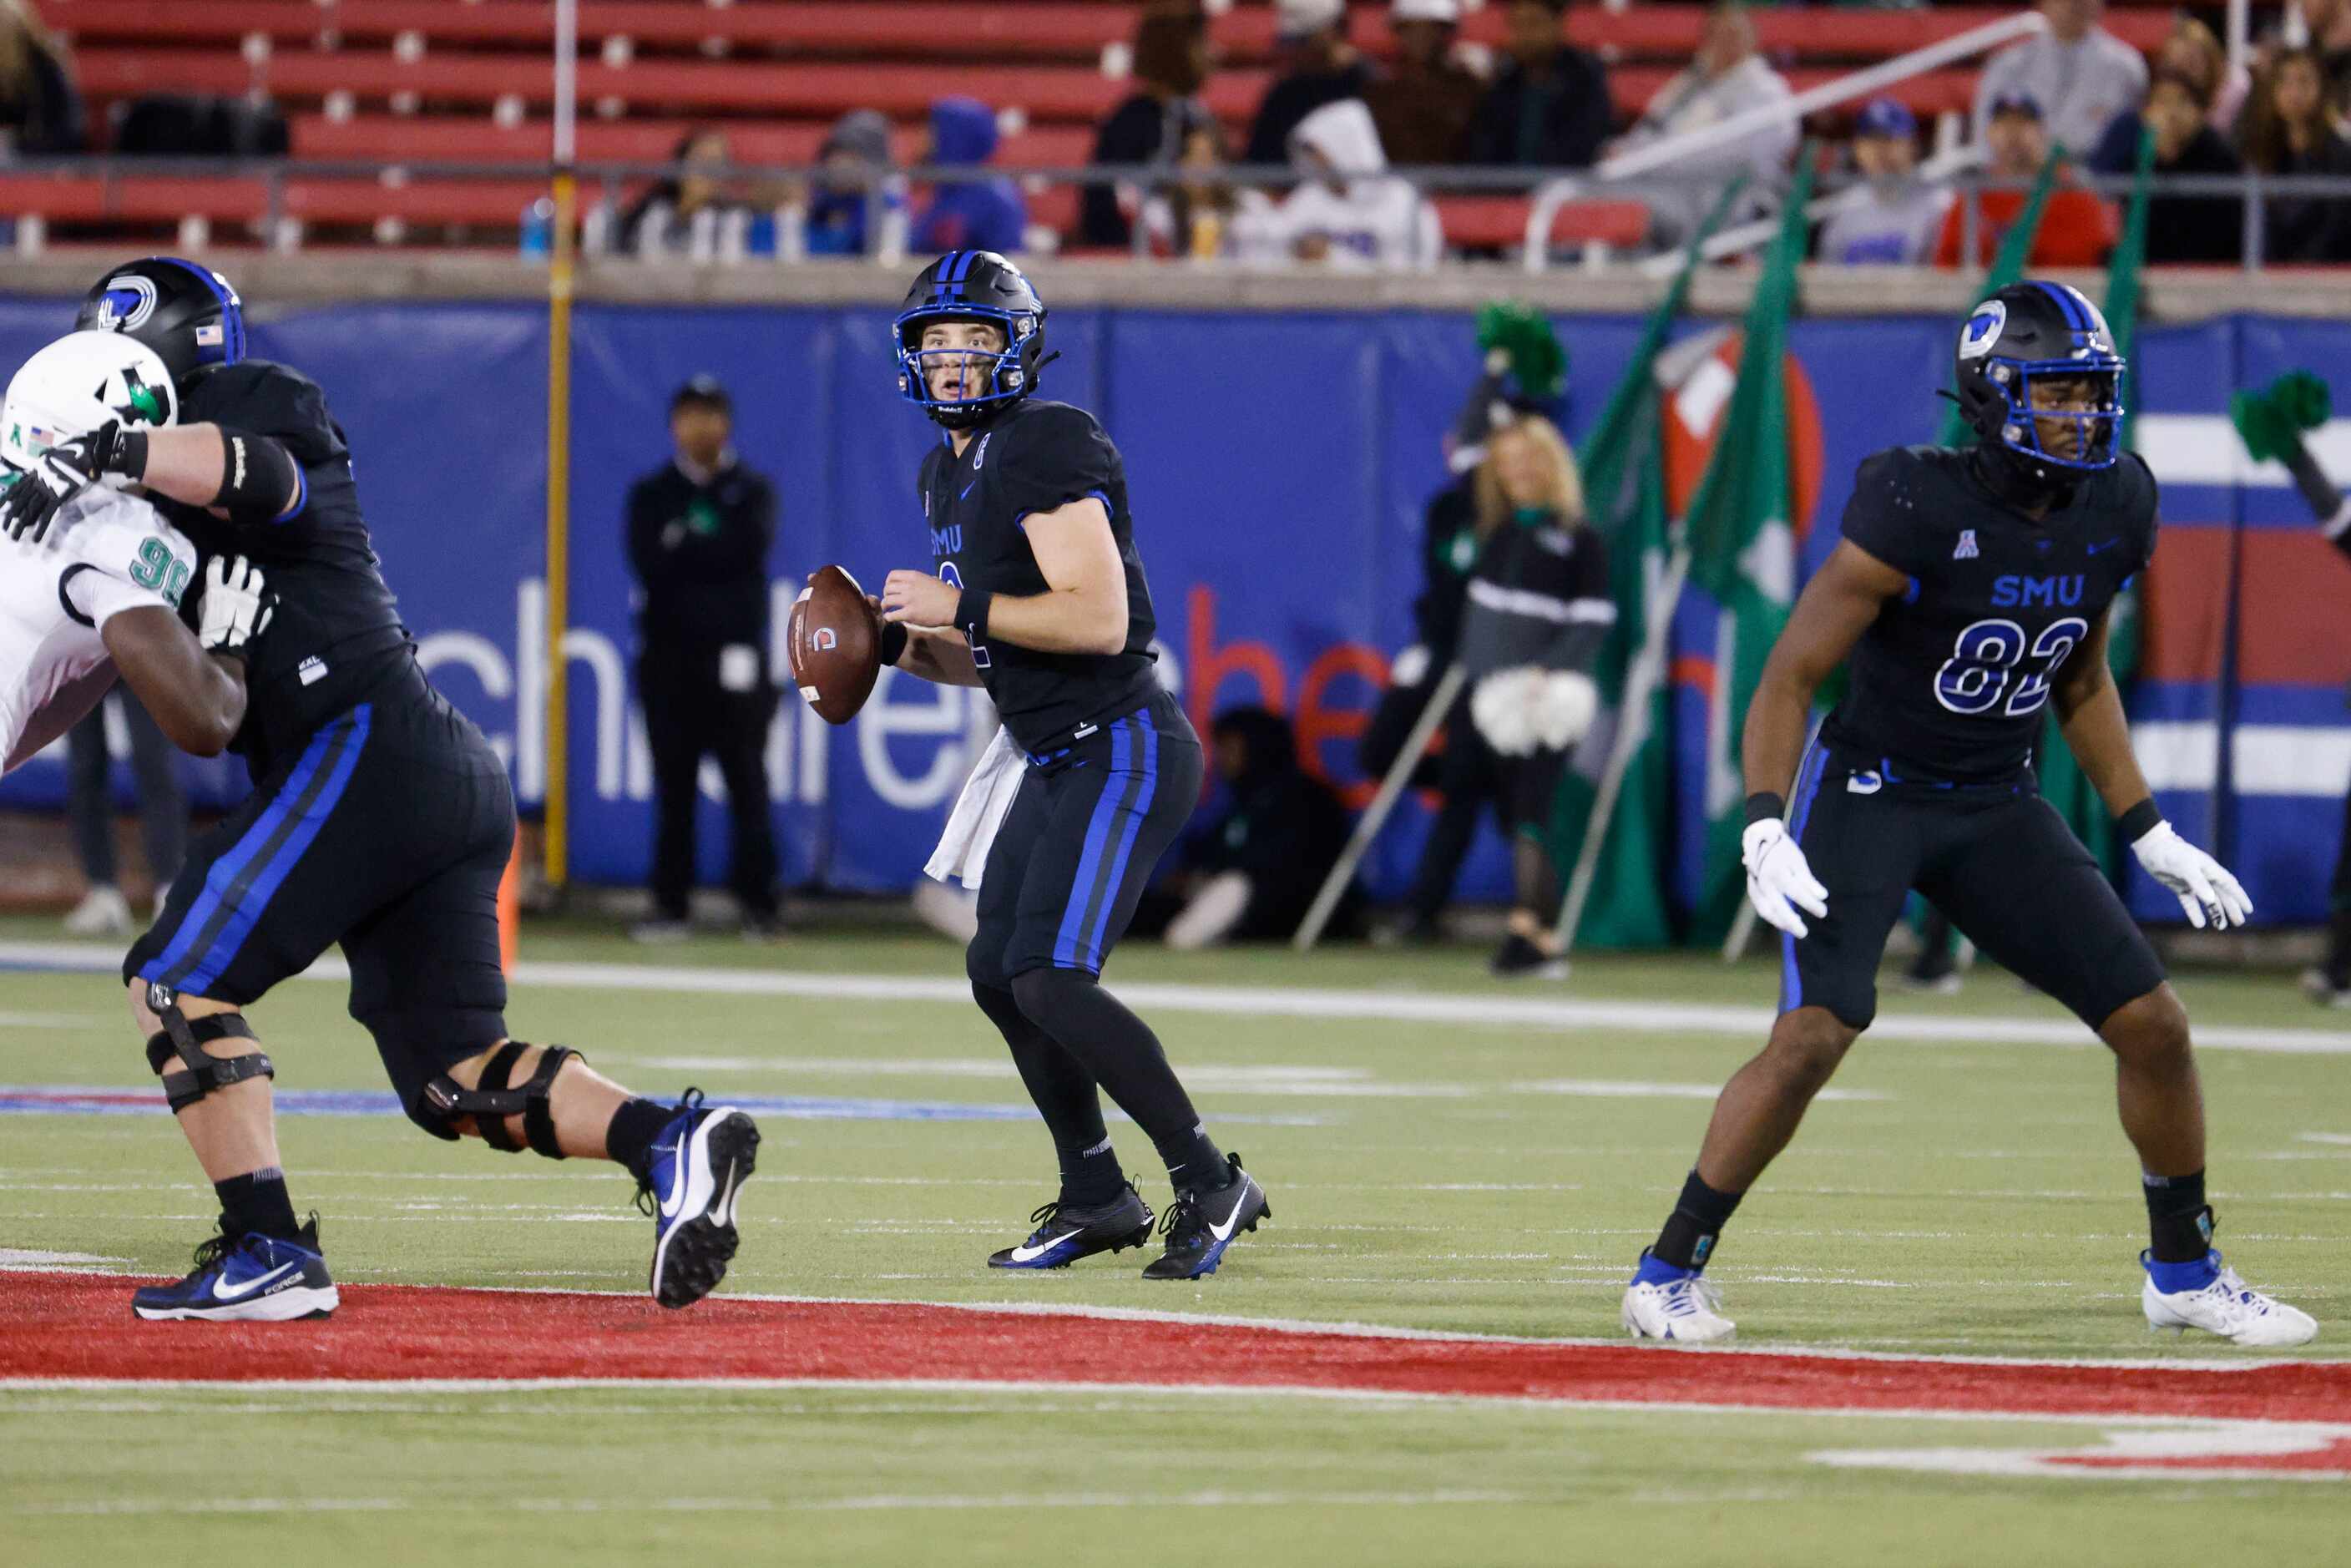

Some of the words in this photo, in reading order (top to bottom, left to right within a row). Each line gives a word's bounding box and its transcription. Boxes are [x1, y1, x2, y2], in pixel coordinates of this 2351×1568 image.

[1990, 574, 2085, 607] SMU
[1934, 617, 2088, 716] 82
[264, 1271, 306, 1296] FORCE
